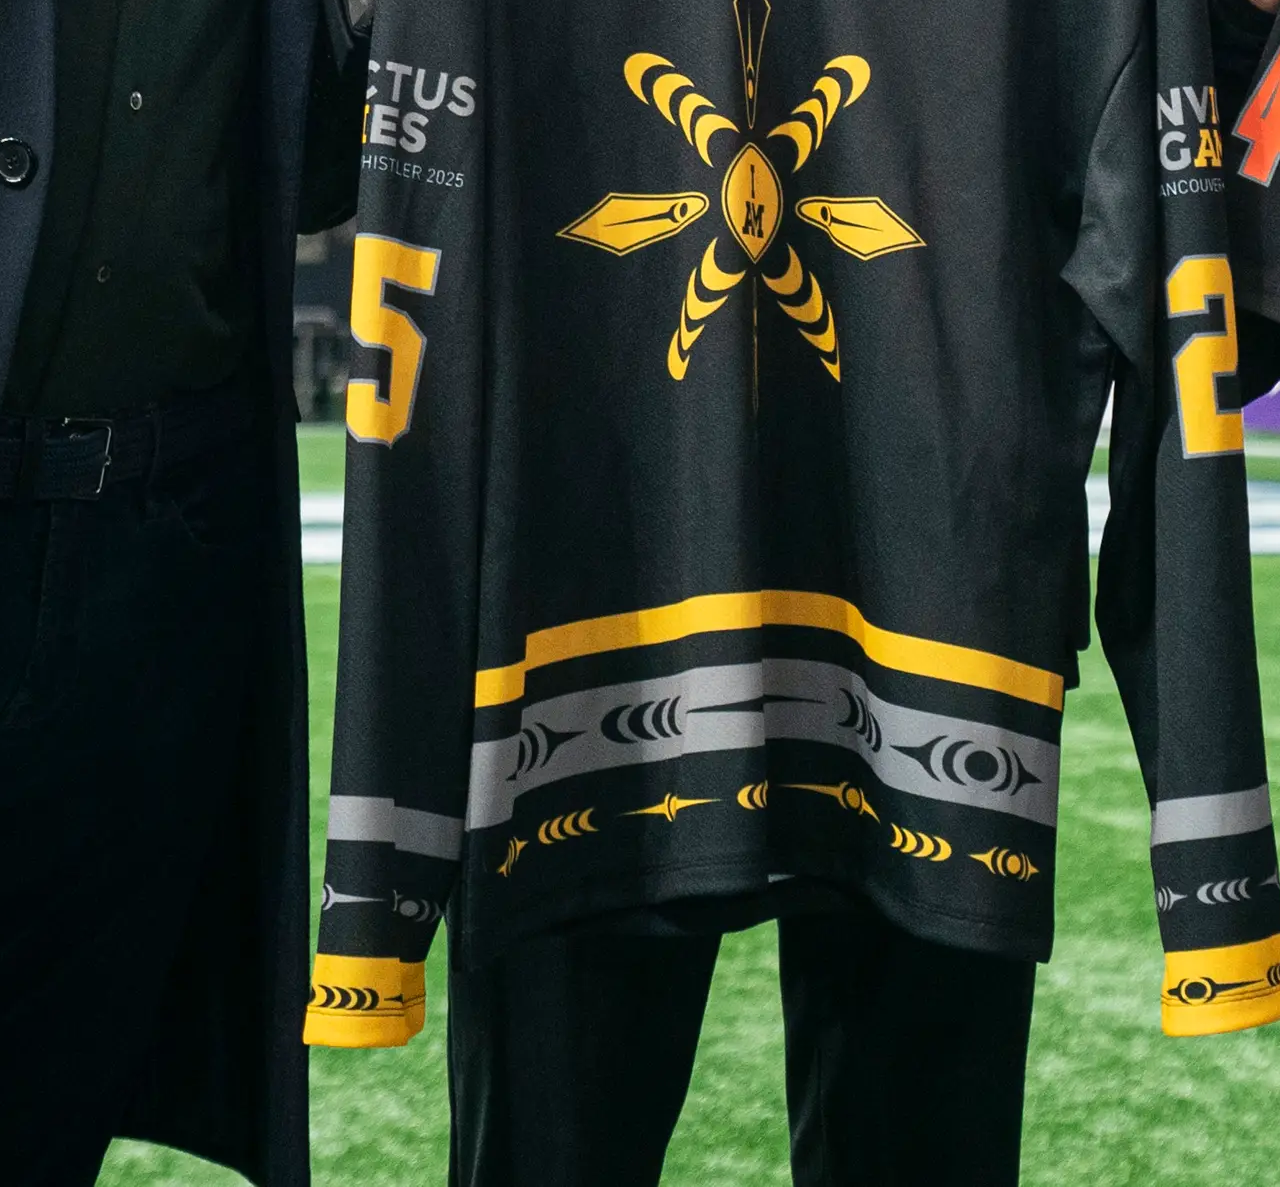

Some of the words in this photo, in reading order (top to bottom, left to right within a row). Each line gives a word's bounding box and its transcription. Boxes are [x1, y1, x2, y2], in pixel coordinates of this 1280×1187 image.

[362, 104, 429, 153] ES
[426, 168, 464, 188] 2025
[345, 233, 442, 449] 5
[1166, 254, 1244, 459] 2
